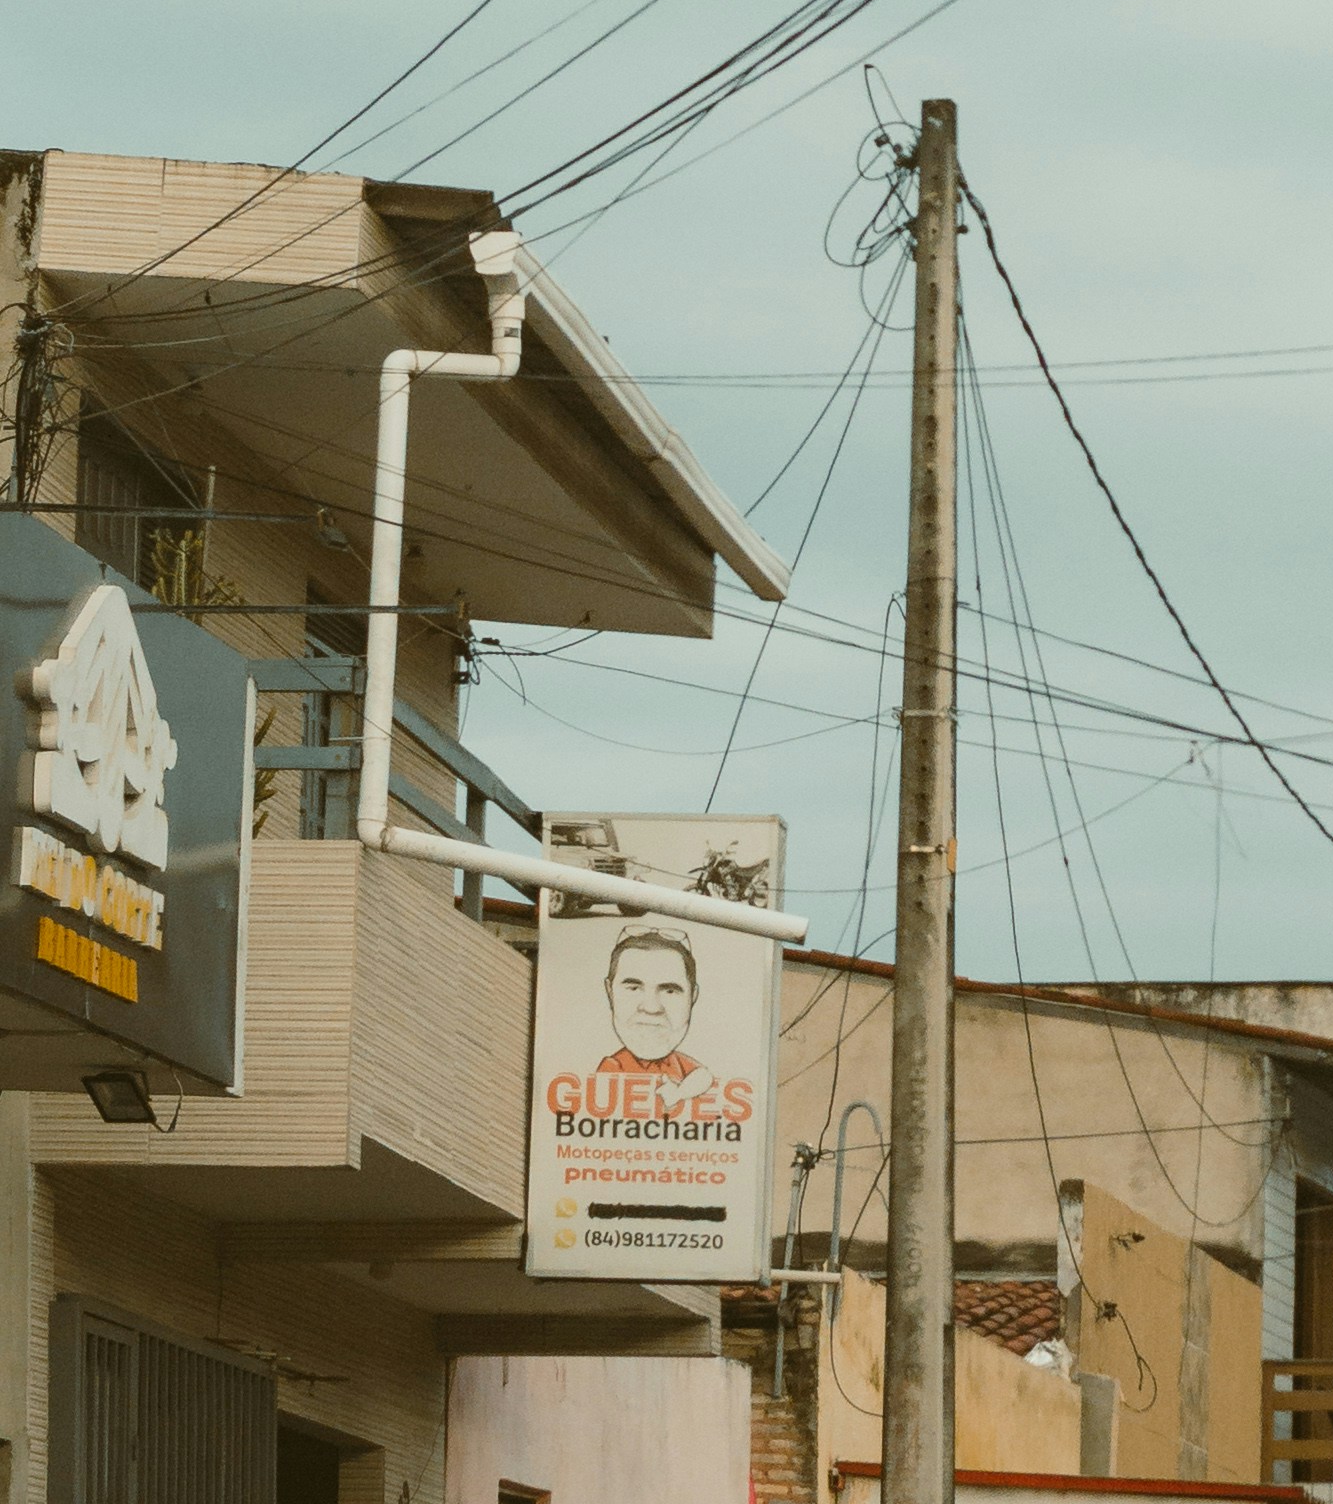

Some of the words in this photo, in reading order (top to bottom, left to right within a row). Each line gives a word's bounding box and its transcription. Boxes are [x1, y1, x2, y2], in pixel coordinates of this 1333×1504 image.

[546, 1072, 754, 1123] GUEDES
[556, 1110, 743, 1143] Borracharia
[556, 1144, 652, 1163] Motopeças
[655, 1151, 666, 1161] e
[668, 1150, 740, 1166] serviços
[564, 1166, 727, 1185] pneumático
[584, 1229, 724, 1251] (84)981172520
